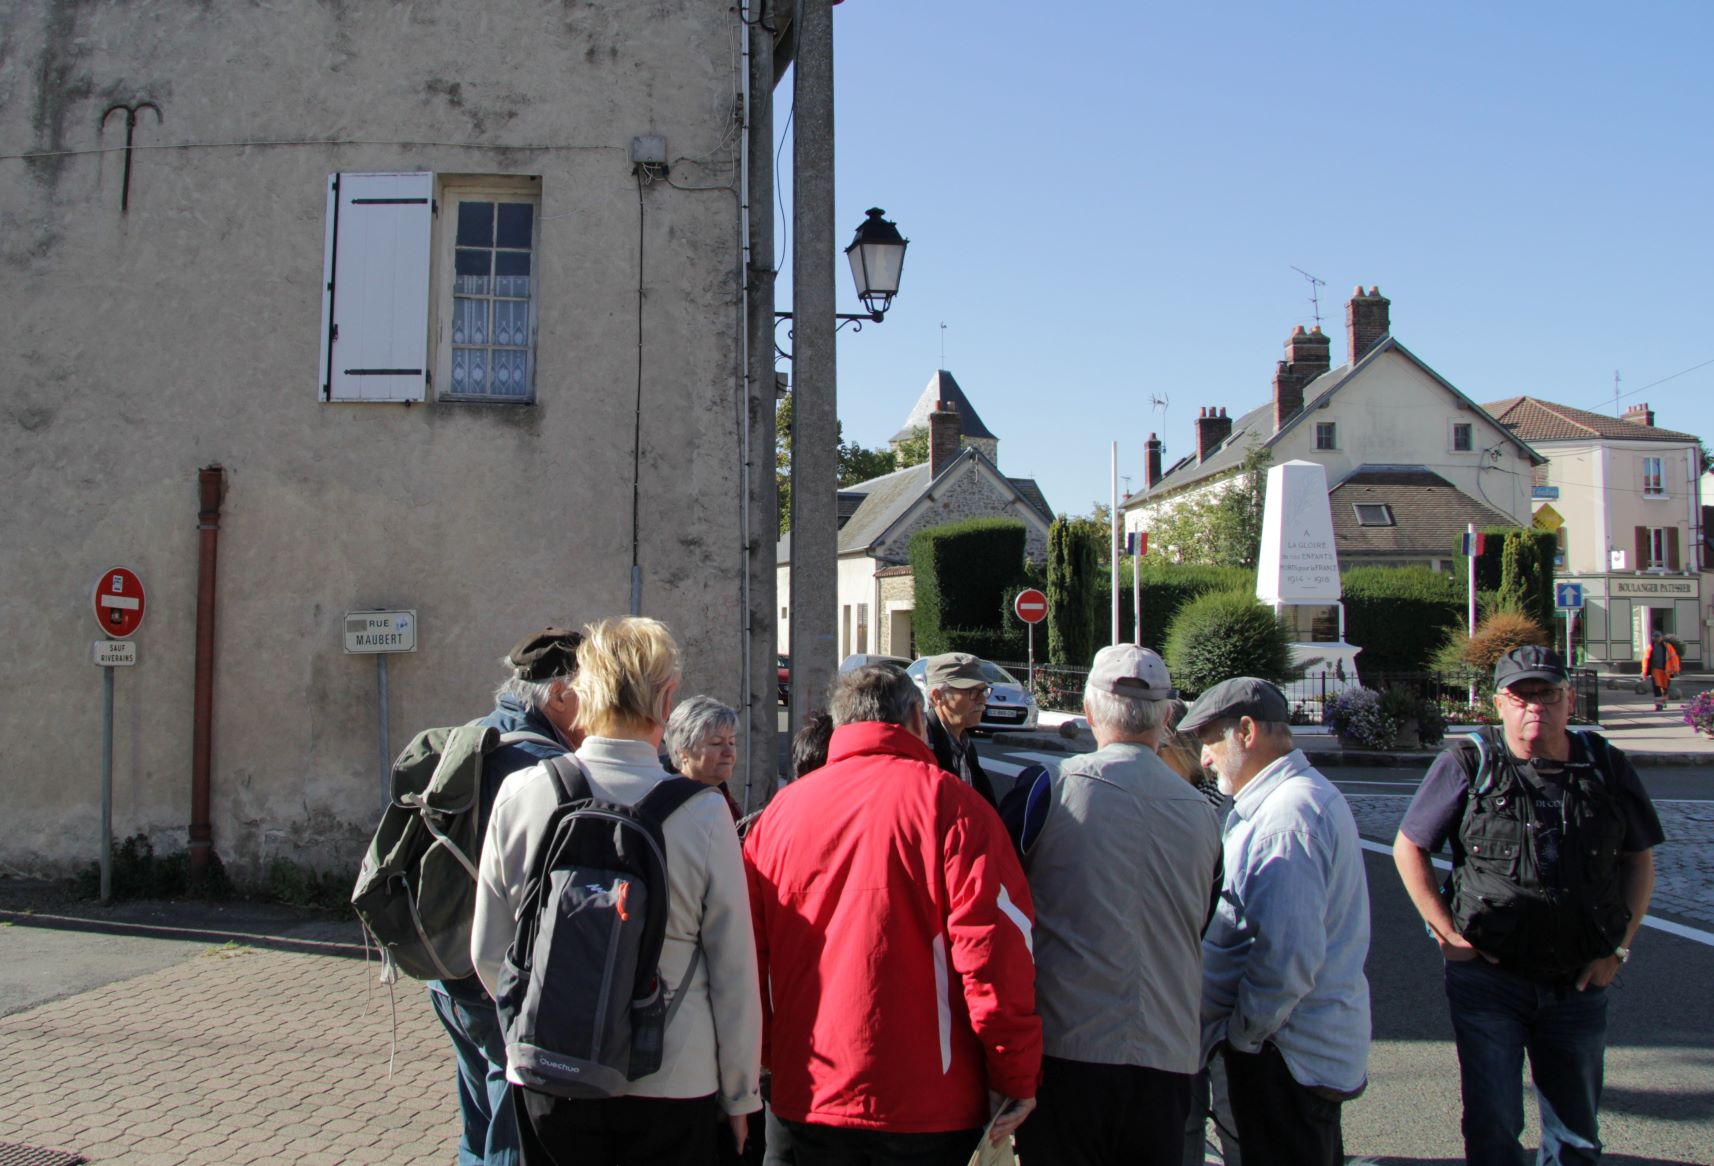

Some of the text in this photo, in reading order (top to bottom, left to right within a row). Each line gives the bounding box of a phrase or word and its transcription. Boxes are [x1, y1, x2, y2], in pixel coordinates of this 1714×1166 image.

[1618, 583, 1657, 592] BOULANGER
[369, 619, 390, 628] RUE
[356, 633, 402, 646] MAUBERT
[110, 644, 126, 652] SAUF
[100, 654, 134, 662] RIVERAINS
[539, 1056, 580, 1073] Quechua
